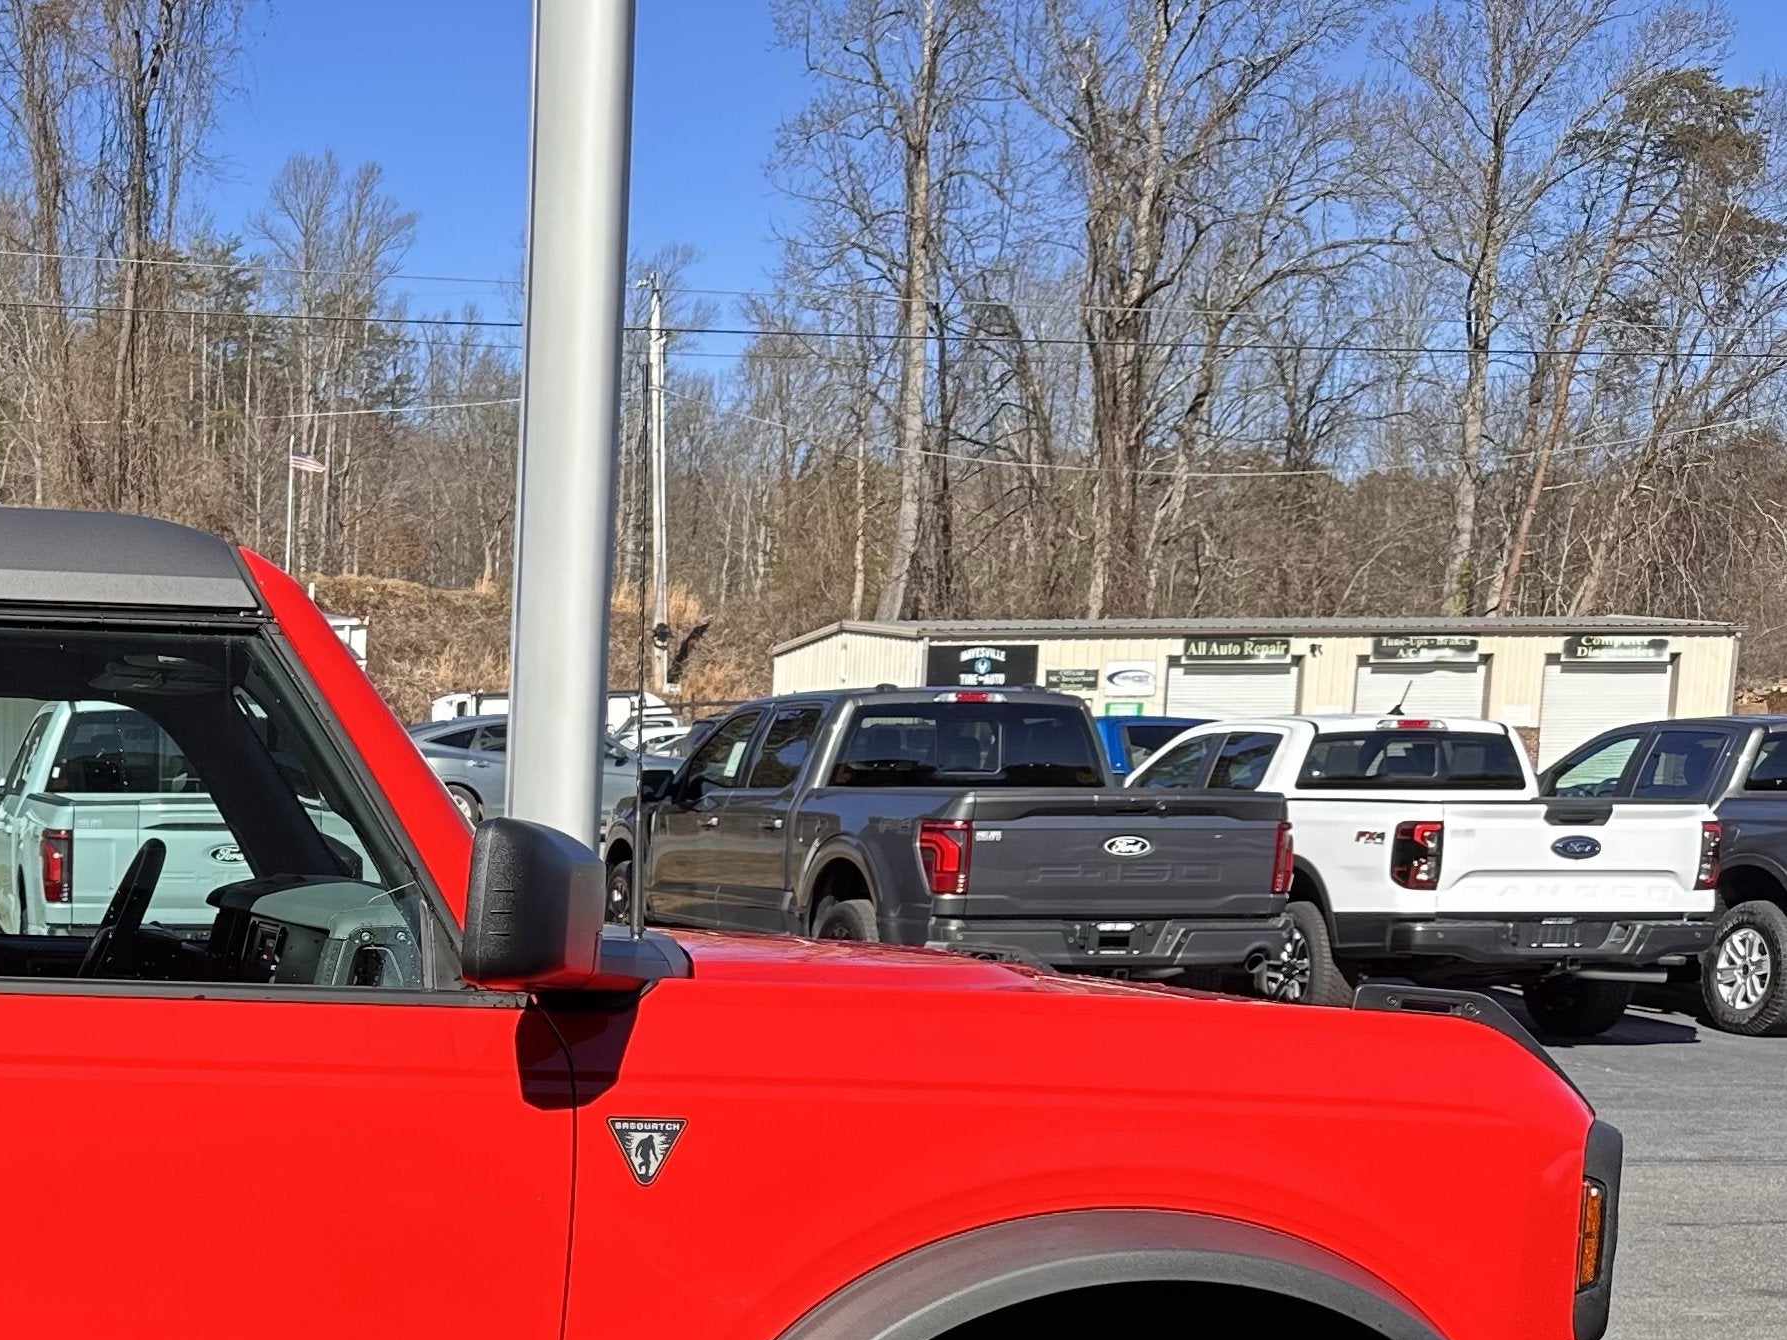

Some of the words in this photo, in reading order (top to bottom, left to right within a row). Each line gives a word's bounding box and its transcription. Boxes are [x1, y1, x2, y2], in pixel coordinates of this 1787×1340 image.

[1186, 641, 1207, 656] All
[1208, 641, 1241, 656] Auto
[1243, 640, 1288, 659] Repair
[1576, 646, 1655, 657] Diaostics
[1027, 862, 1223, 884] F-150
[1464, 884, 1674, 899] RANGER
[614, 1121, 681, 1131] SASQUATCH
